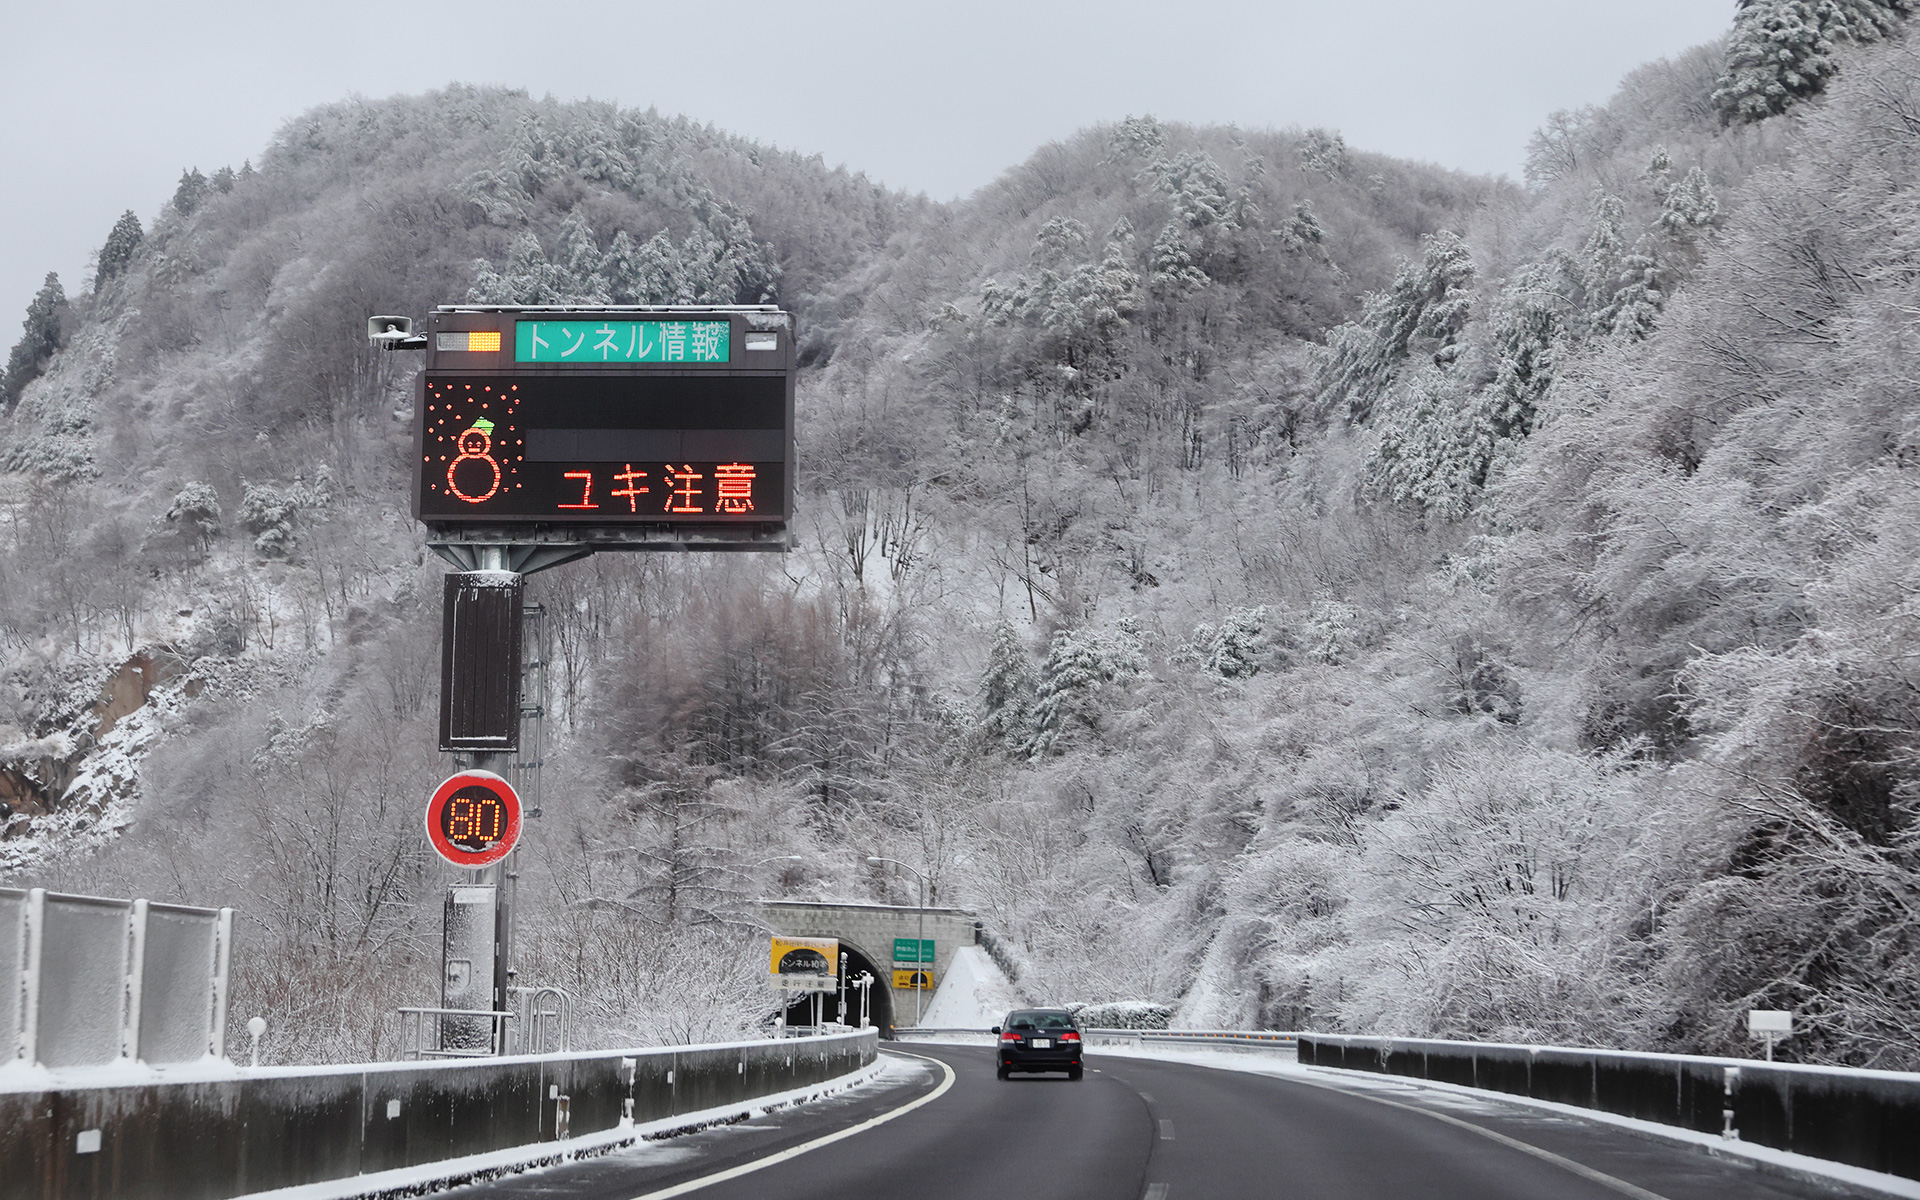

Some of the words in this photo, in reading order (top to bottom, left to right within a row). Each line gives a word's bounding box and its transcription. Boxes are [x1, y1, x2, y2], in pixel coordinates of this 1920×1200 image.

[530, 322, 720, 362] トンネル情報
[557, 462, 756, 513] ユキ注意
[449, 798, 500, 841] 80
